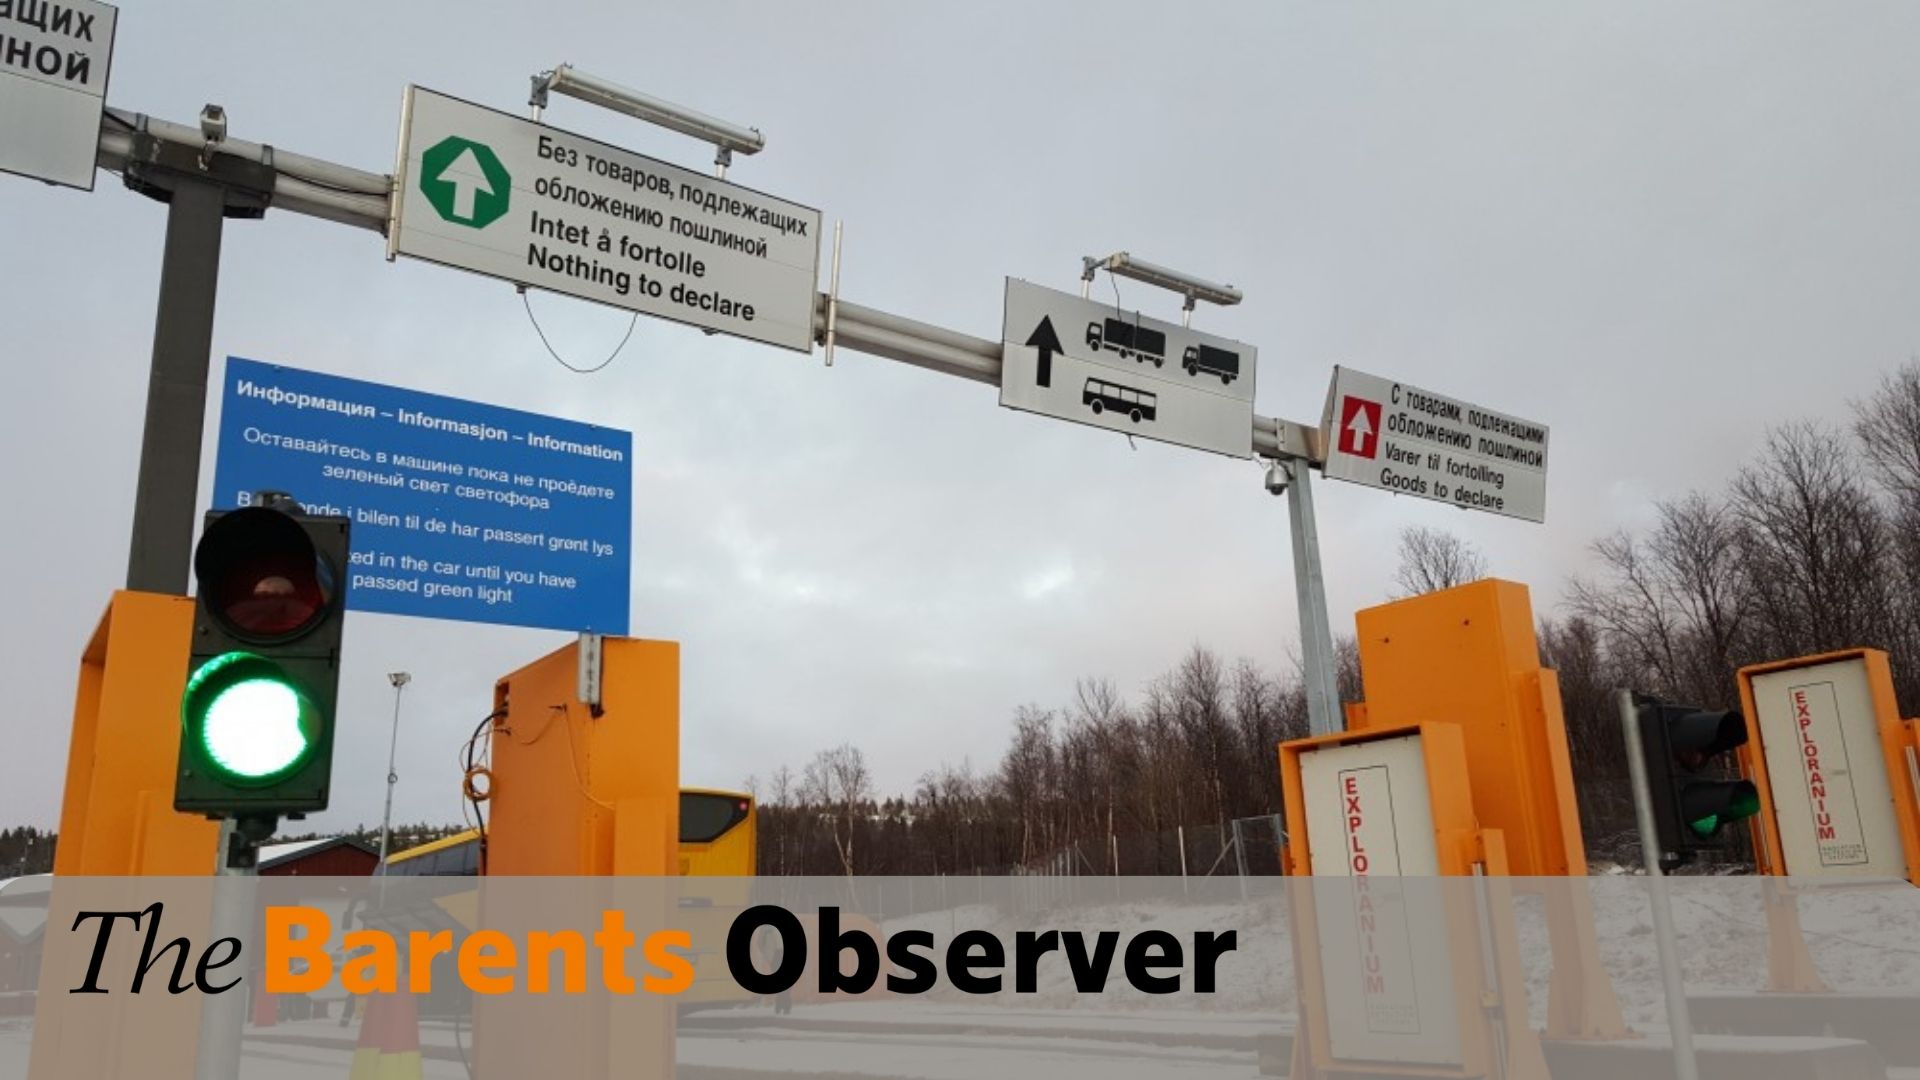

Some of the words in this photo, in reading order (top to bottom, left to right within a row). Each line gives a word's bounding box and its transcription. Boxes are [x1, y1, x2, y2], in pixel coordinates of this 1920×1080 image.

[537, 135, 578, 168] Без
[586, 153, 675, 200] товаров,
[680, 182, 808, 237] подлежащих
[530, 210, 590, 247] Intet
[597, 228, 612, 253] å
[619, 235, 706, 278] fortolle
[535, 176, 664, 228] обложению
[670, 215, 768, 259] пошлиной
[527, 243, 631, 297] Nothing
[638, 272, 663, 299] to
[669, 283, 756, 322] declare
[237, 379, 376, 420] Информация
[398, 408, 509, 442] Informasjon
[527, 432, 624, 463] Information
[1391, 383, 1401, 405] С
[243, 426, 372, 463] Оставайтесь
[375, 451, 388, 464] в
[393, 453, 464, 476] машине
[467, 463, 510, 484] пока
[513, 472, 535, 487] не
[1385, 441, 1421, 467] Varer
[1427, 452, 1440, 471] til
[1446, 457, 1505, 490] fortolling
[1388, 412, 1472, 450] обложению
[1478, 436, 1543, 468] пошлиной
[322, 463, 405, 489] зеленый
[408, 476, 450, 494] свет
[454, 482, 551, 511] светофора
[1380, 467, 1428, 495] Goods
[1433, 481, 1449, 499] to
[1454, 485, 1504, 511] declare
[357, 507, 400, 528] bilen
[404, 514, 420, 531] til
[424, 516, 447, 534] de
[452, 521, 480, 539] har
[483, 527, 545, 547] passert
[548, 536, 589, 553] grønt
[592, 541, 614, 558] lys
[352, 573, 419, 593] passed
[423, 583, 474, 599] green
[477, 584, 513, 605] light
[379, 552, 396, 568] in
[400, 554, 429, 573] the
[433, 560, 461, 576] car
[466, 563, 500, 581] until
[504, 570, 535, 586] you
[538, 571, 577, 590] have
[1794, 690, 1836, 841] EXPLORANIUM
